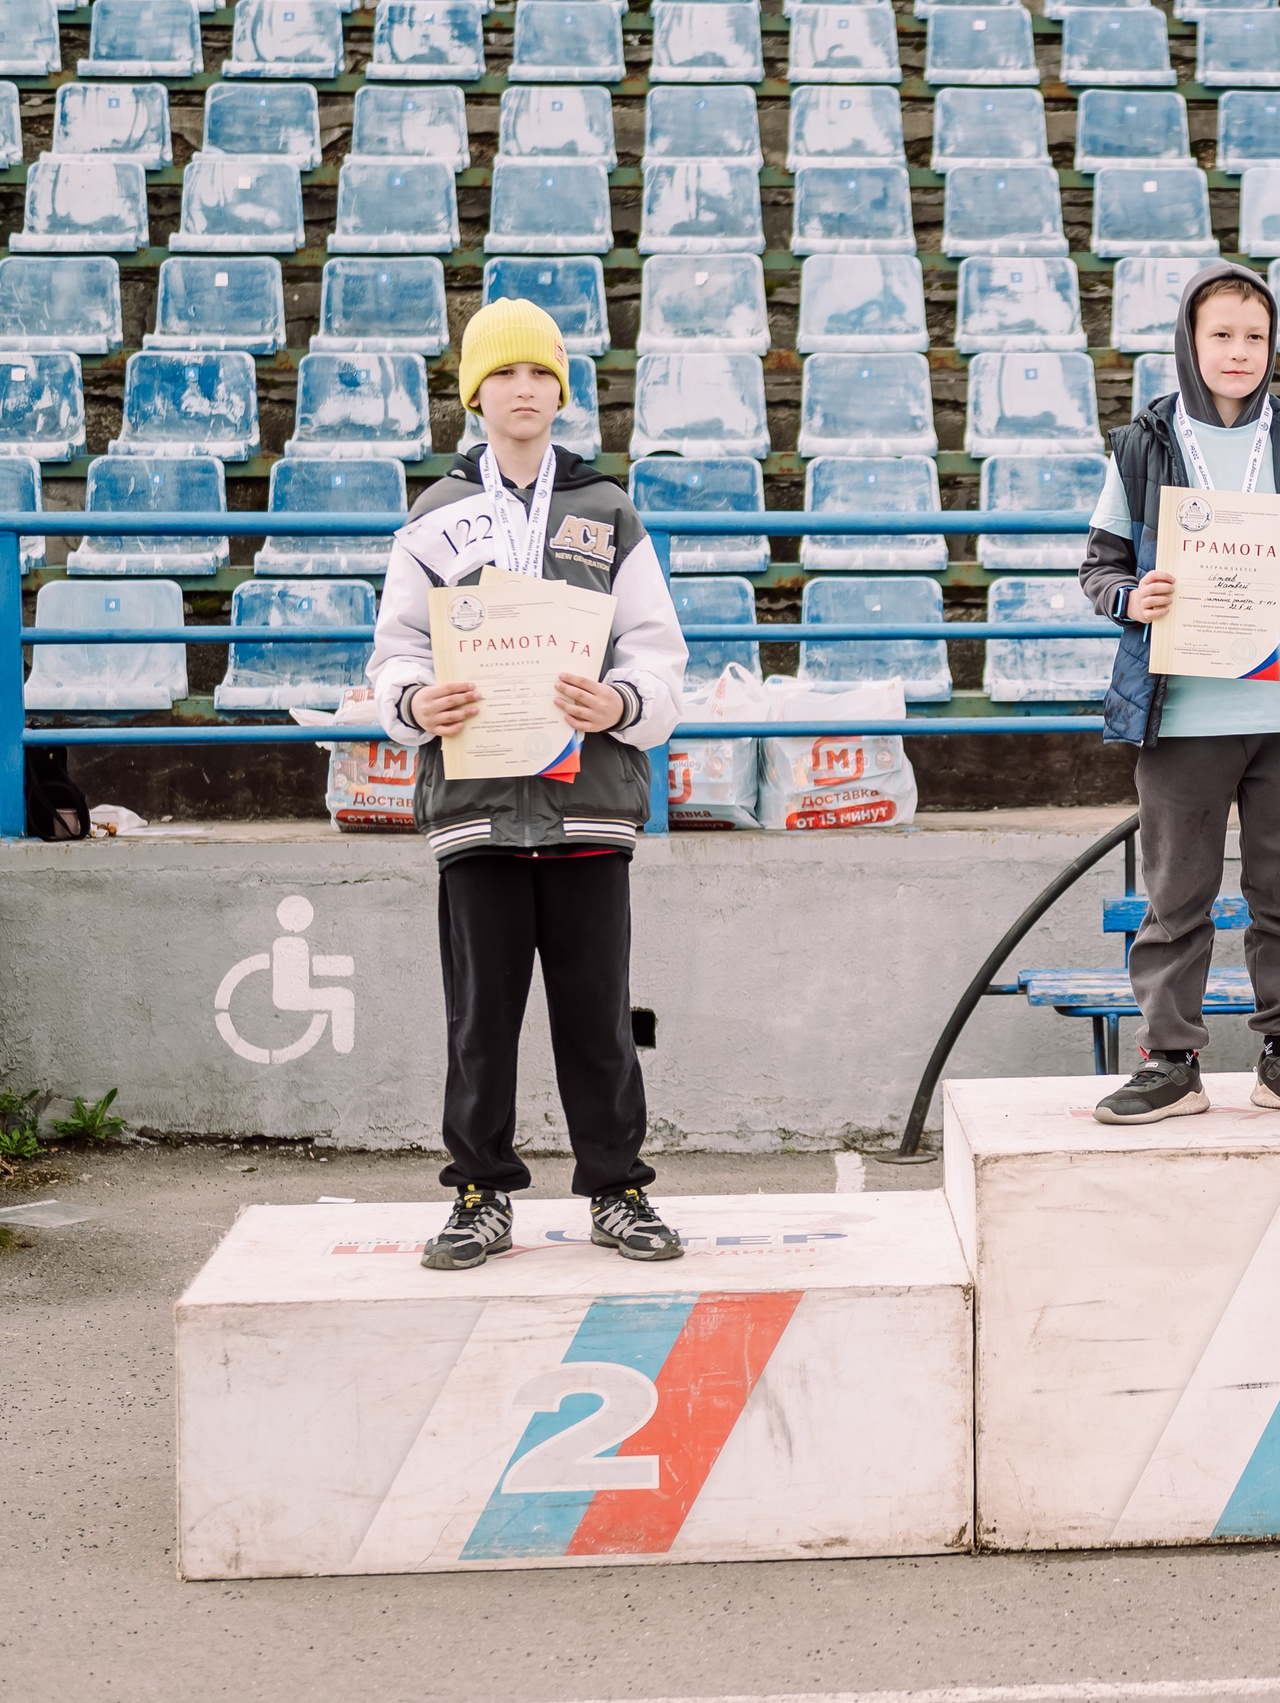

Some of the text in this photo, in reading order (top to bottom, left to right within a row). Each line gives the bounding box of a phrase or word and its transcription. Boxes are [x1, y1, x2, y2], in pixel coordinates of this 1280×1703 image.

[442, 514, 493, 558] 122
[550, 515, 616, 563] ACL
[555, 552, 573, 560] NEW
[1183, 539, 1277, 558] ГРАМОТА
[109, 601, 116, 609] 4
[459, 634, 558, 652] ГРАМОТА
[802, 789, 880, 808] Доставка
[347, 814, 366, 824] от
[370, 814, 387, 823] 15
[796, 805, 888, 829] от 15 минут
[501, 1360, 660, 1494] 2
